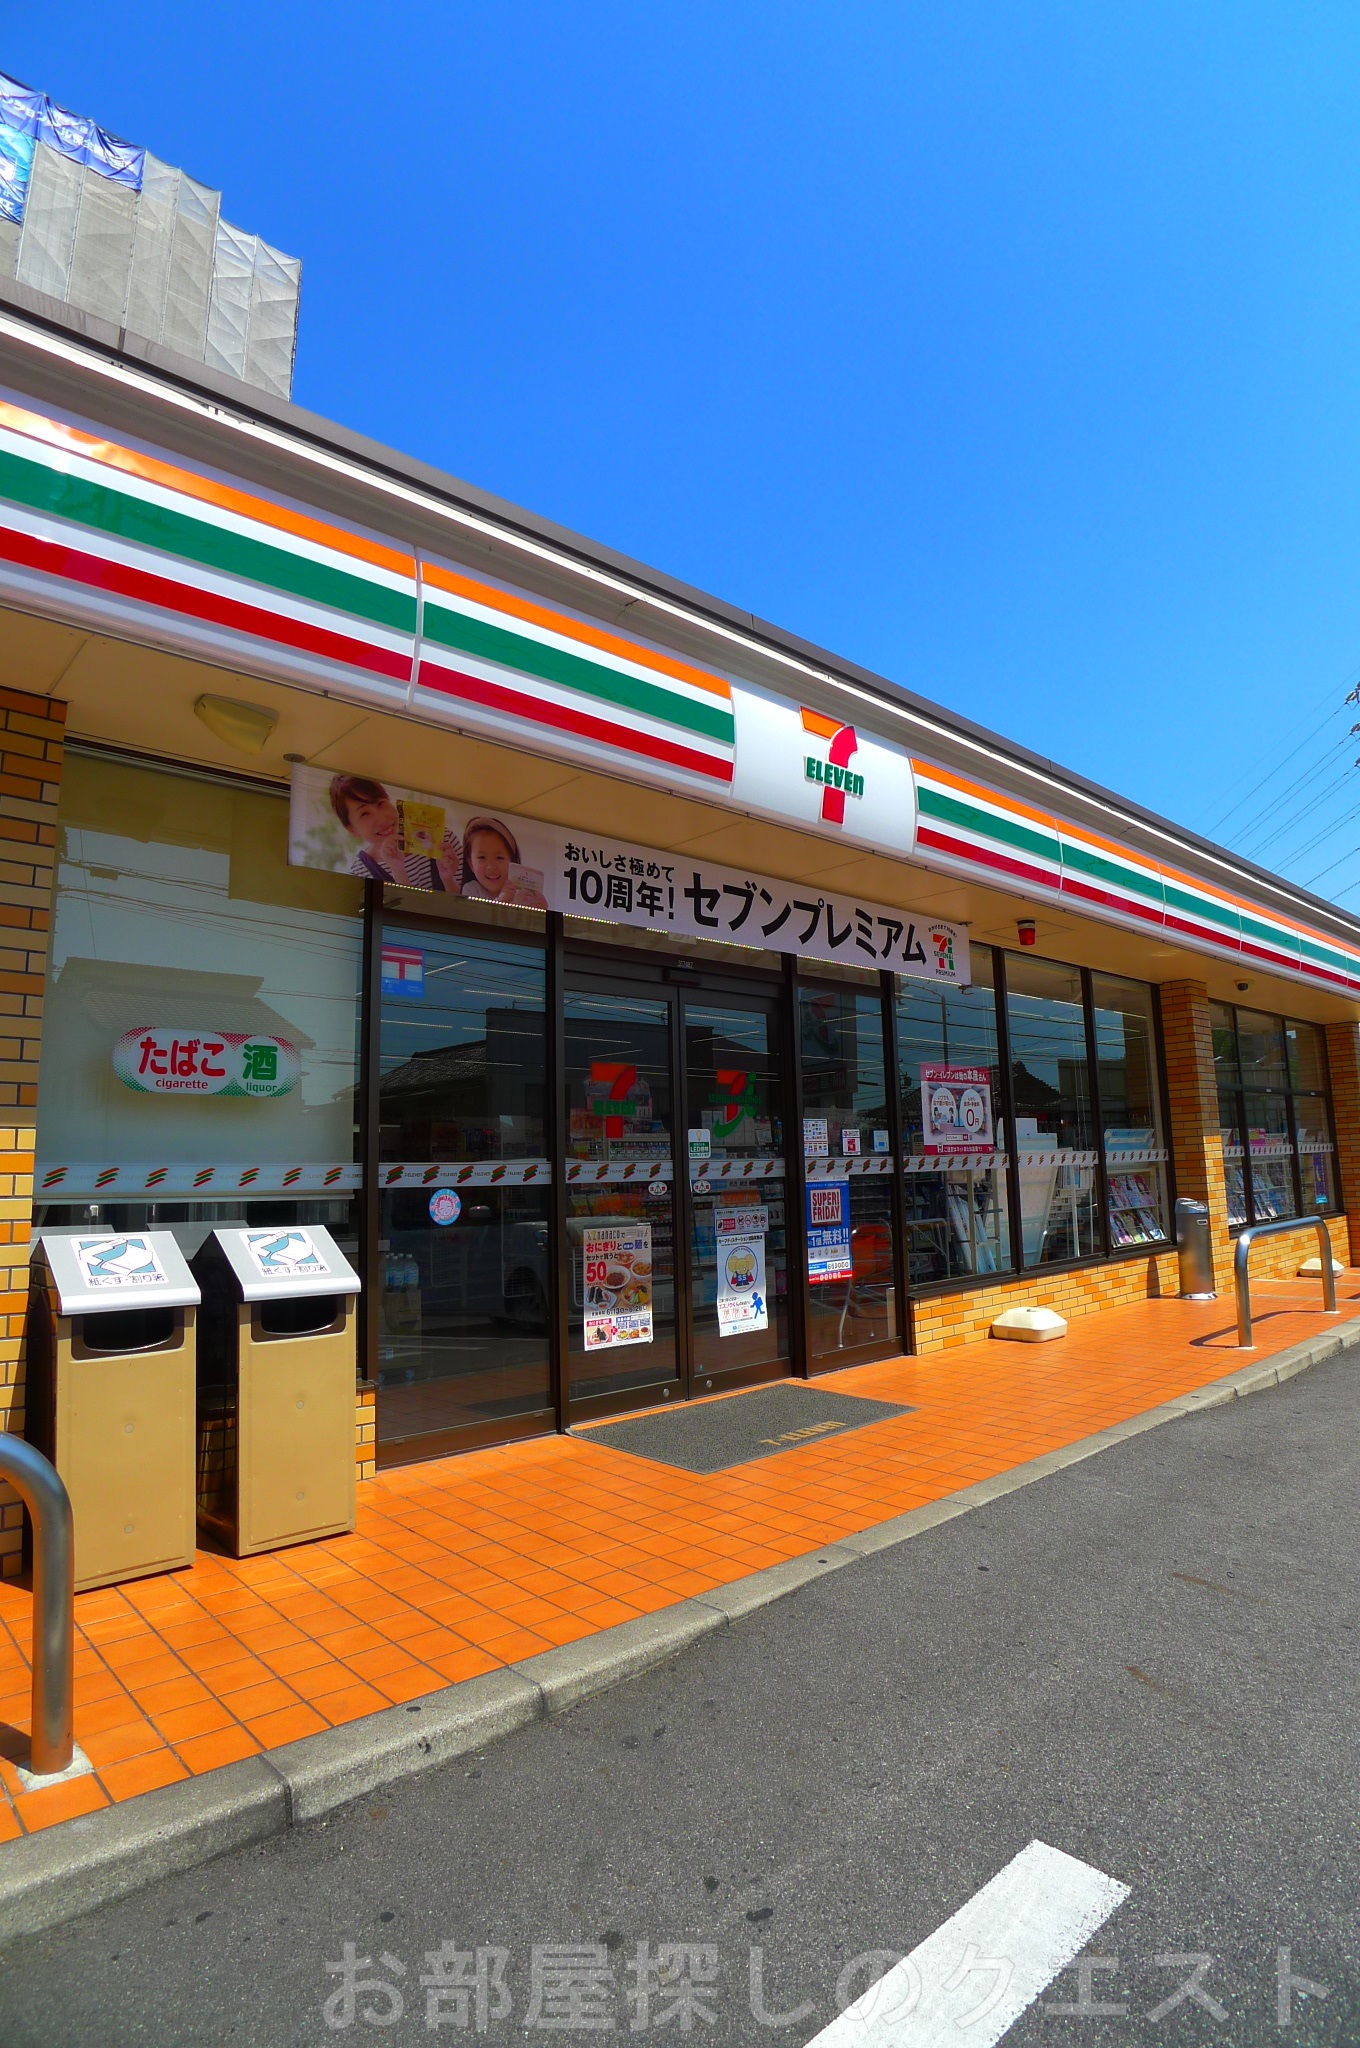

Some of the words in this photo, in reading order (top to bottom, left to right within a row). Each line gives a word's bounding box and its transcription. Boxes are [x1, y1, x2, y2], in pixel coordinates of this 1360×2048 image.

[564, 842, 675, 883] おいしさ極めて
[563, 866, 675, 920] 10周年!
[684, 871, 927, 966] セブンプレミアム
[138, 1036, 226, 1077] たばこ
[242, 1043, 278, 1080] 酒
[155, 1077, 208, 1090] cigarette
[246, 1082, 277, 1093] liquor
[812, 1205, 840, 1221] FRIDAY
[586, 1261, 607, 1282] 50
